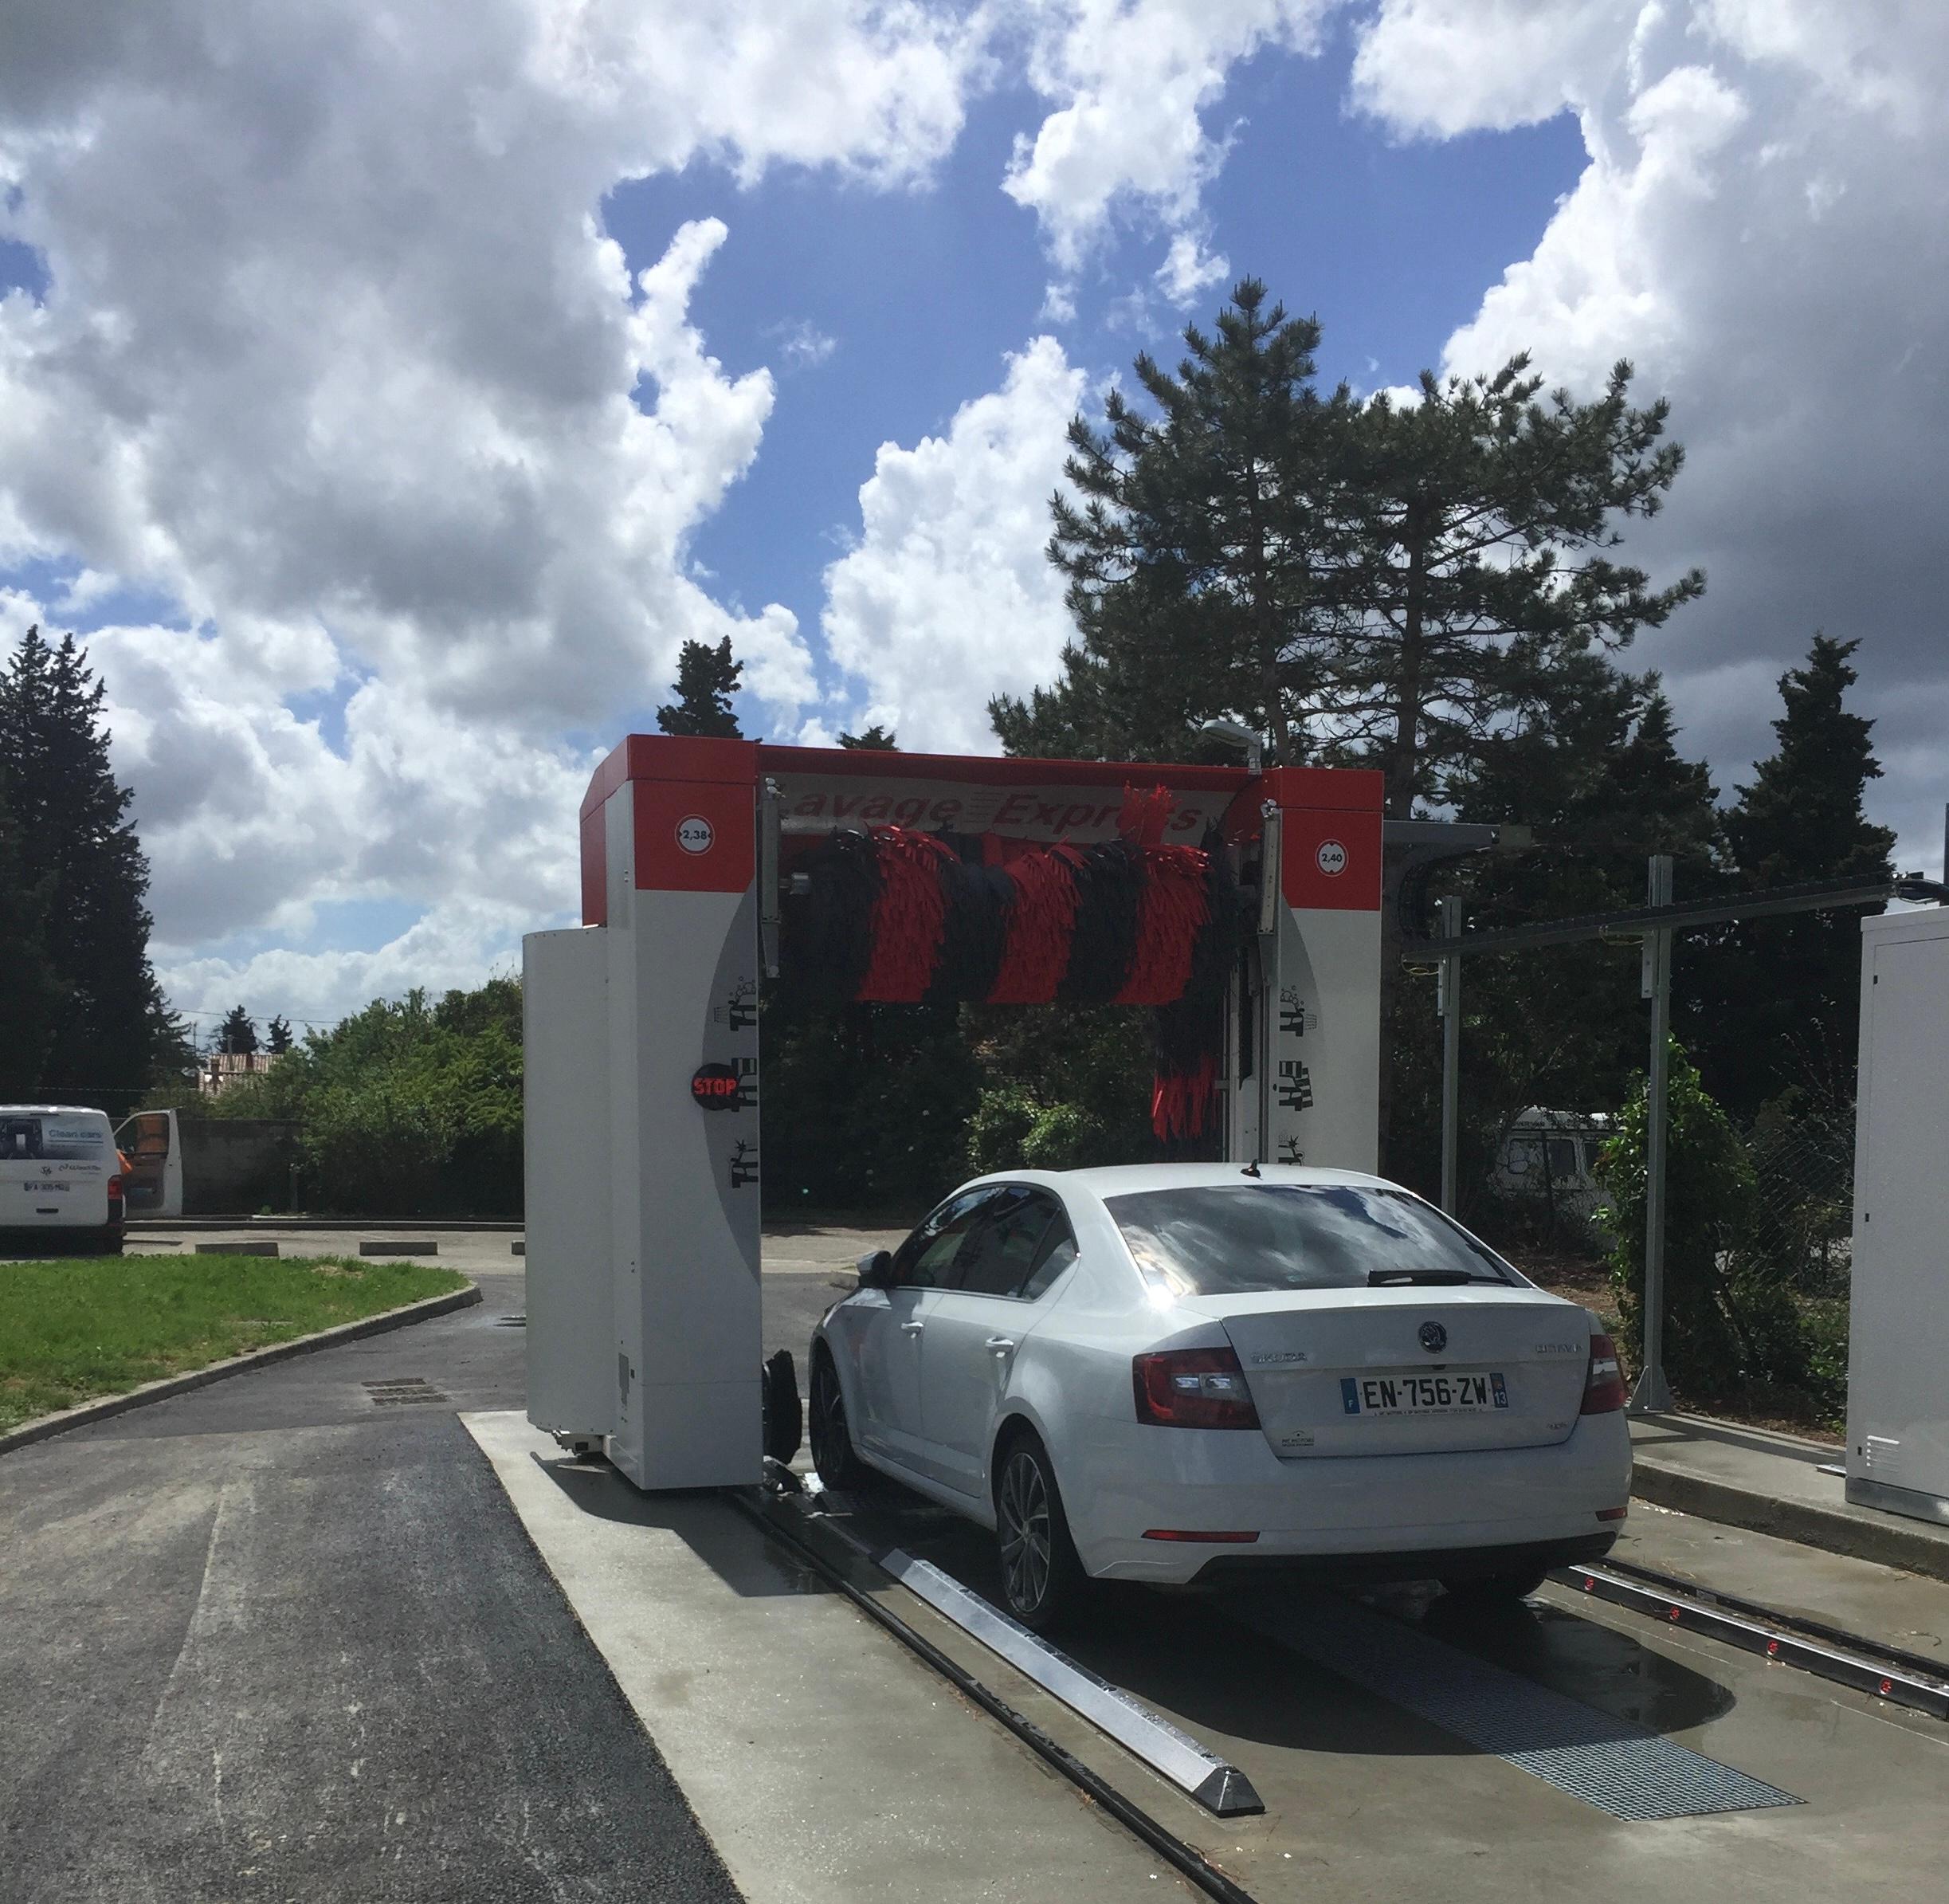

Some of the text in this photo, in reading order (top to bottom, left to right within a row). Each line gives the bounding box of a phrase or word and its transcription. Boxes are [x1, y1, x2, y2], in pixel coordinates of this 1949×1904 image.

[778, 792, 1202, 834] avage Exprs
[683, 830, 708, 841] 2,38
[1322, 853, 1343, 863] 2,40
[693, 1078, 737, 1095] STOP
[1347, 1377, 1507, 1408] F EN-756-ZW 13
